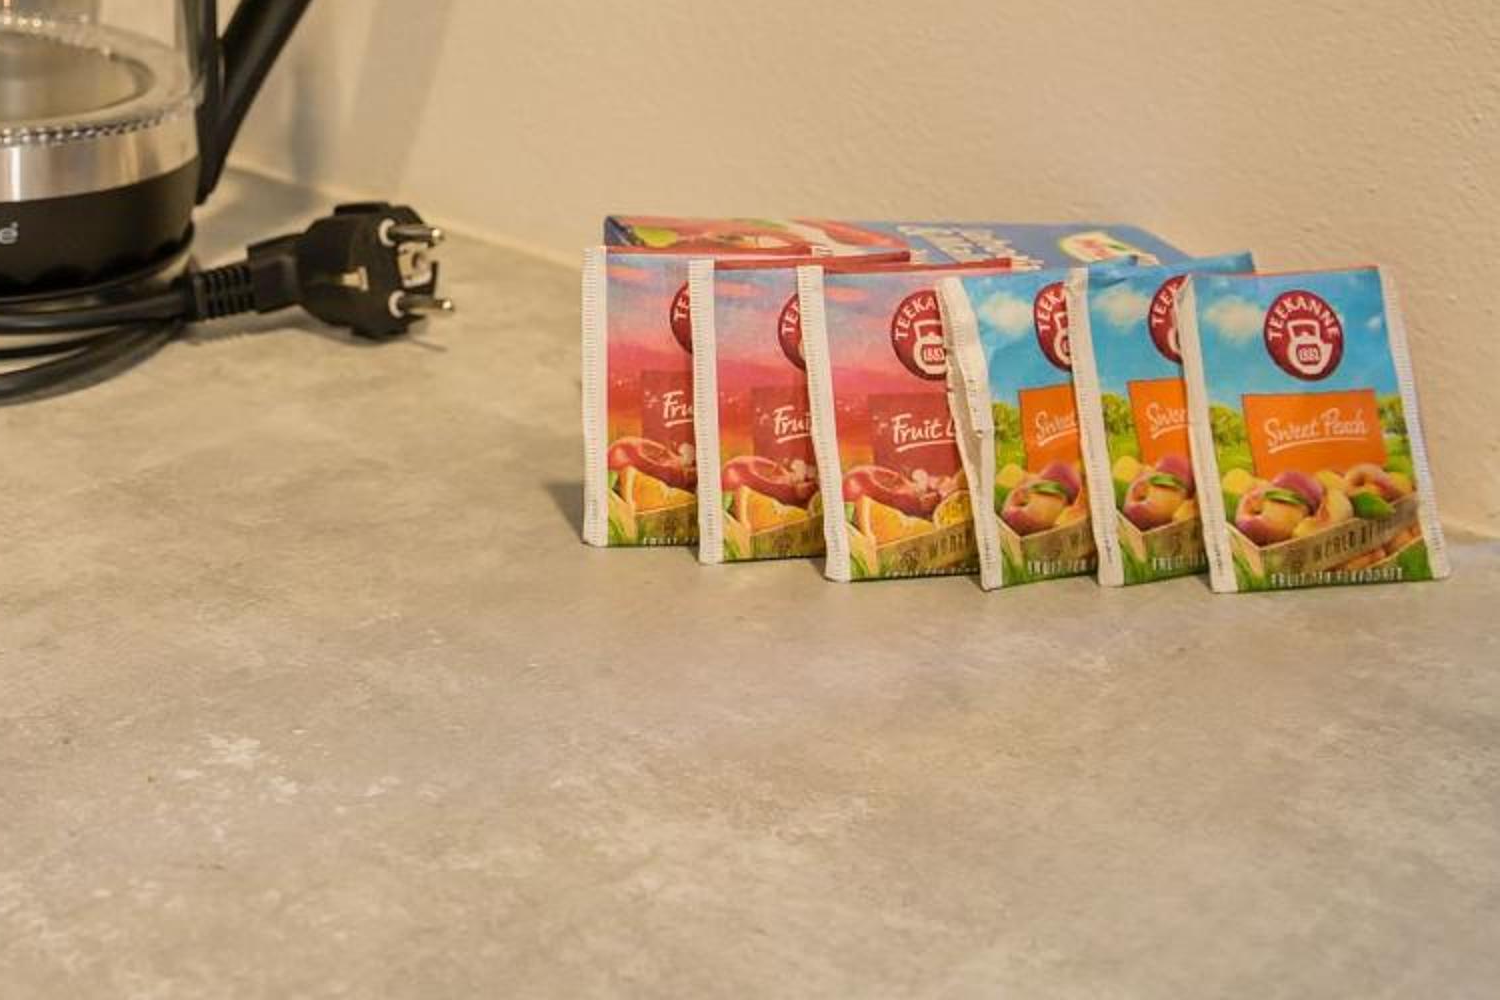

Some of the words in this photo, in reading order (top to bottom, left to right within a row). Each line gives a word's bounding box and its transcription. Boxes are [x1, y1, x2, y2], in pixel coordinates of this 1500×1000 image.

[1267, 295, 1340, 341] TEEKANNE
[891, 412, 943, 444] Fruit
[1264, 417, 1318, 447] Sweet
[1319, 407, 1368, 436] Peach
